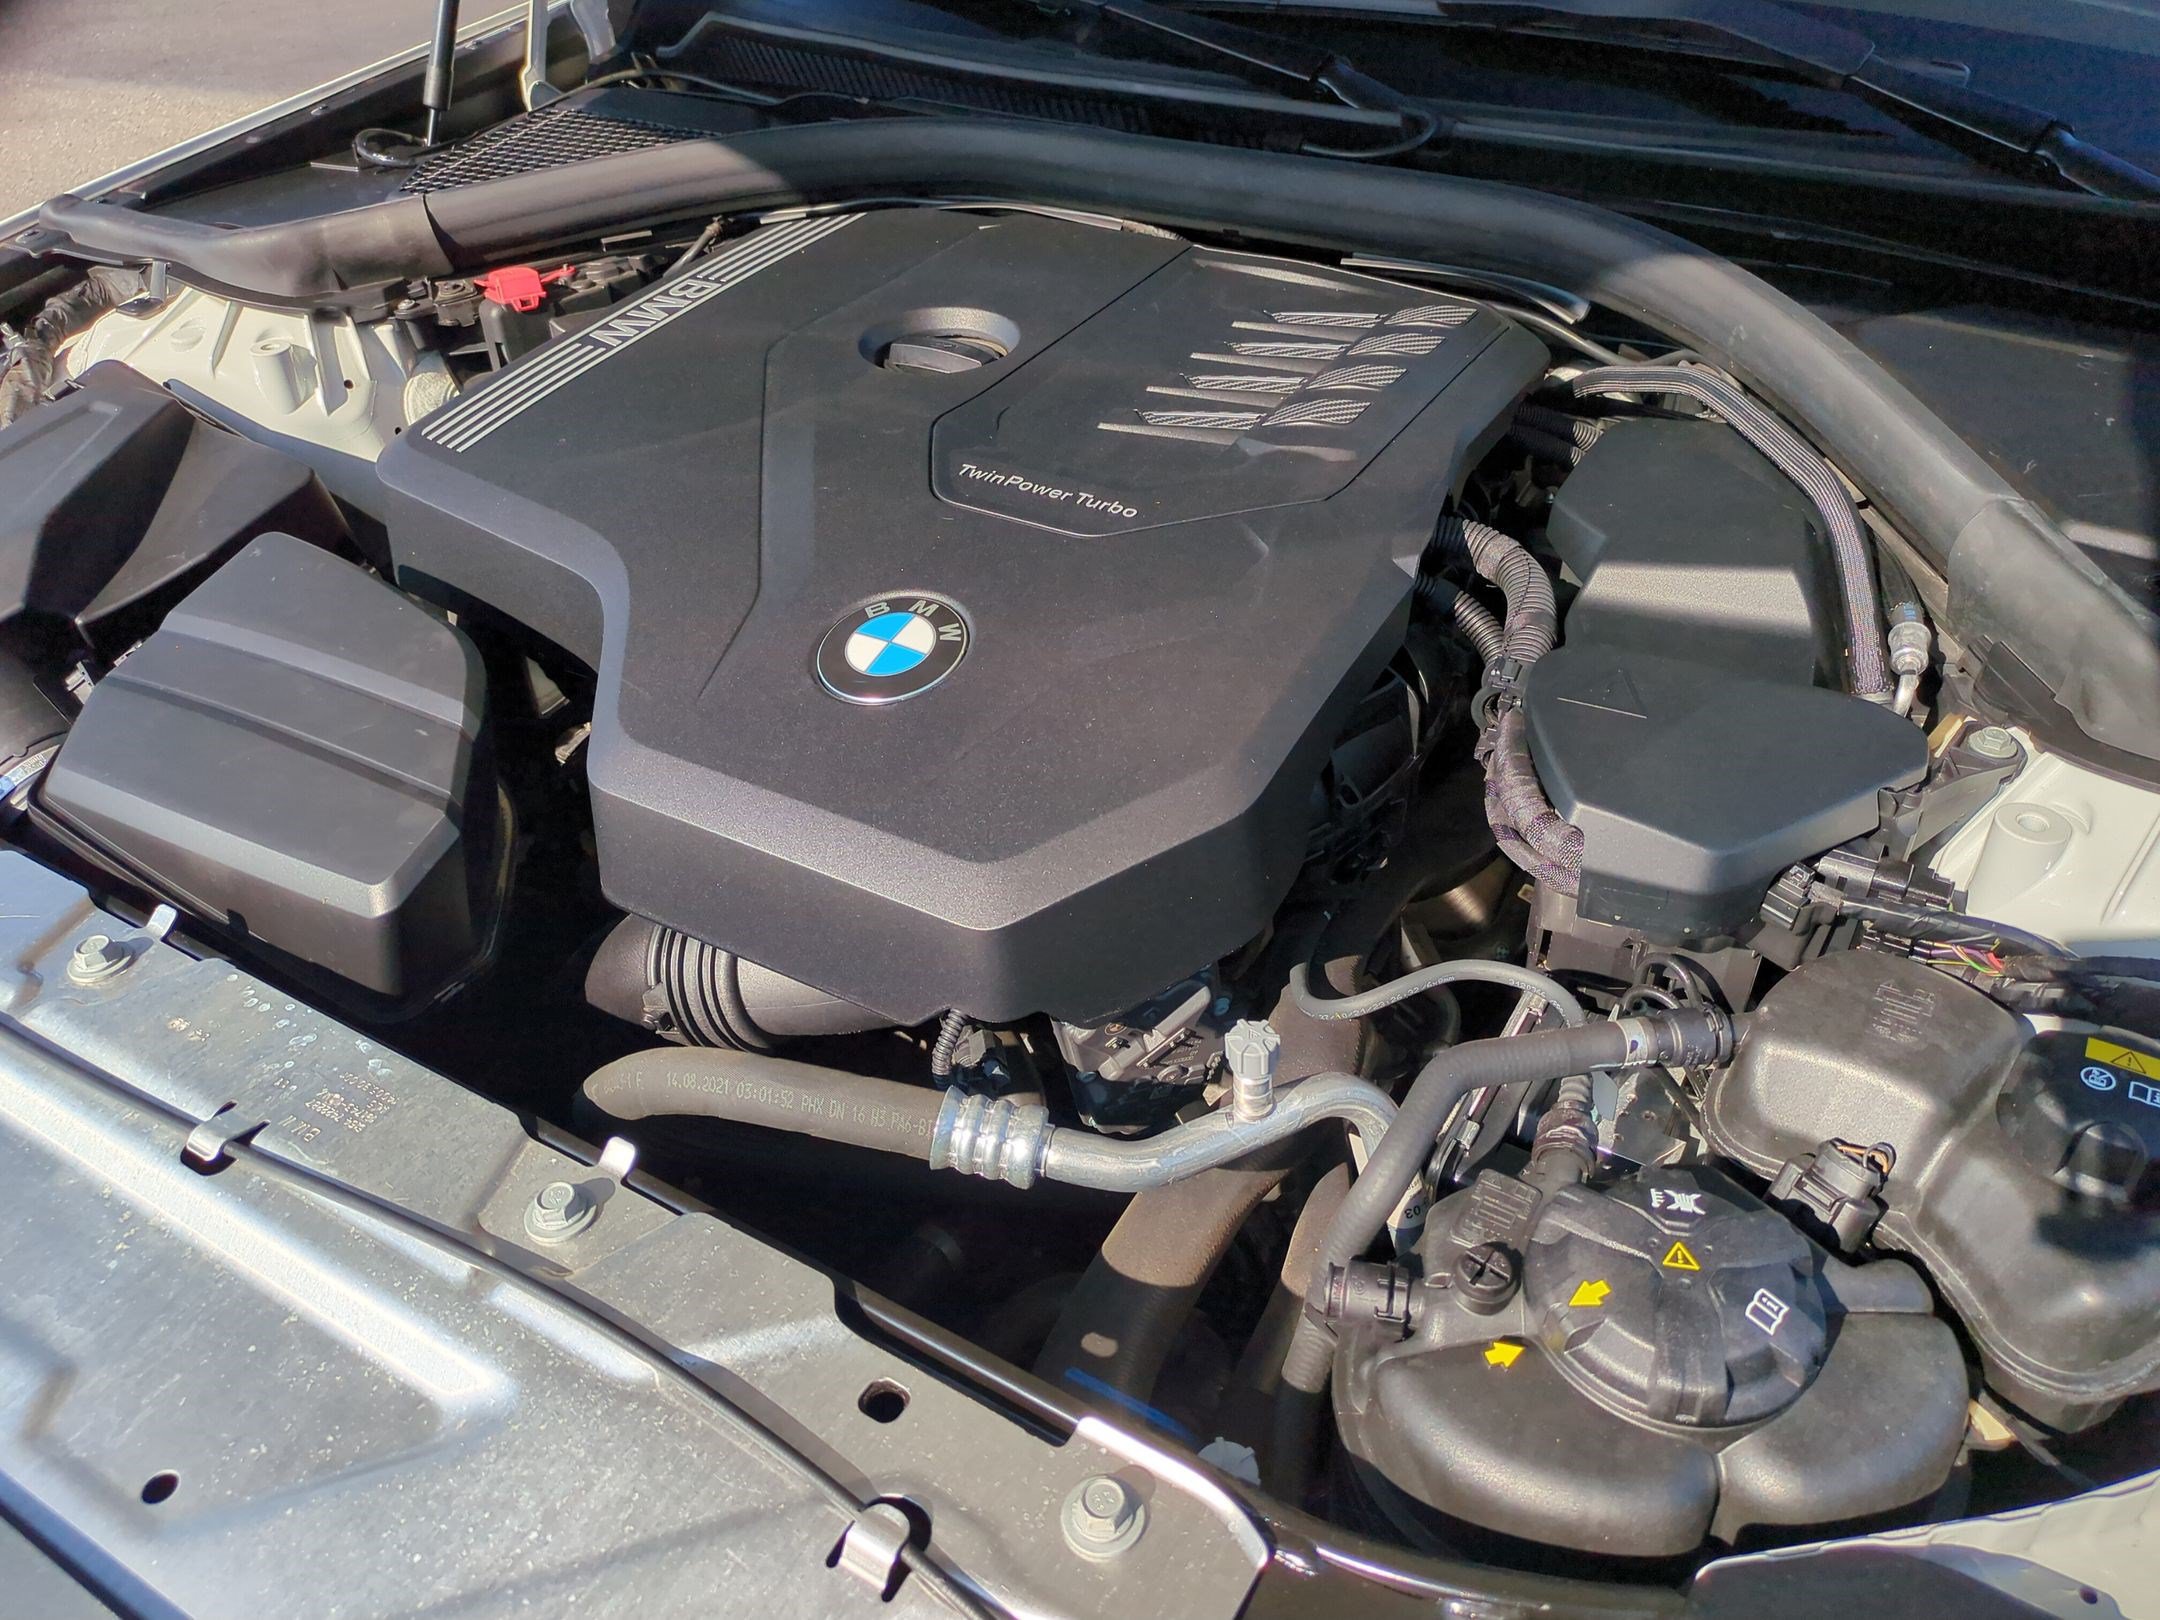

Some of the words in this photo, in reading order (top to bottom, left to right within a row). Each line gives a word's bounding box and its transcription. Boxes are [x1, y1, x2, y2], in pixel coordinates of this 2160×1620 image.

[588, 278, 722, 347] BMW
[957, 463, 1074, 501] TwinPower
[1076, 492, 1138, 518] Turbo
[864, 600, 962, 642] BMW
[665, 1071, 730, 1095] 14.08.2021
[736, 1081, 795, 1109] 03:01:52
